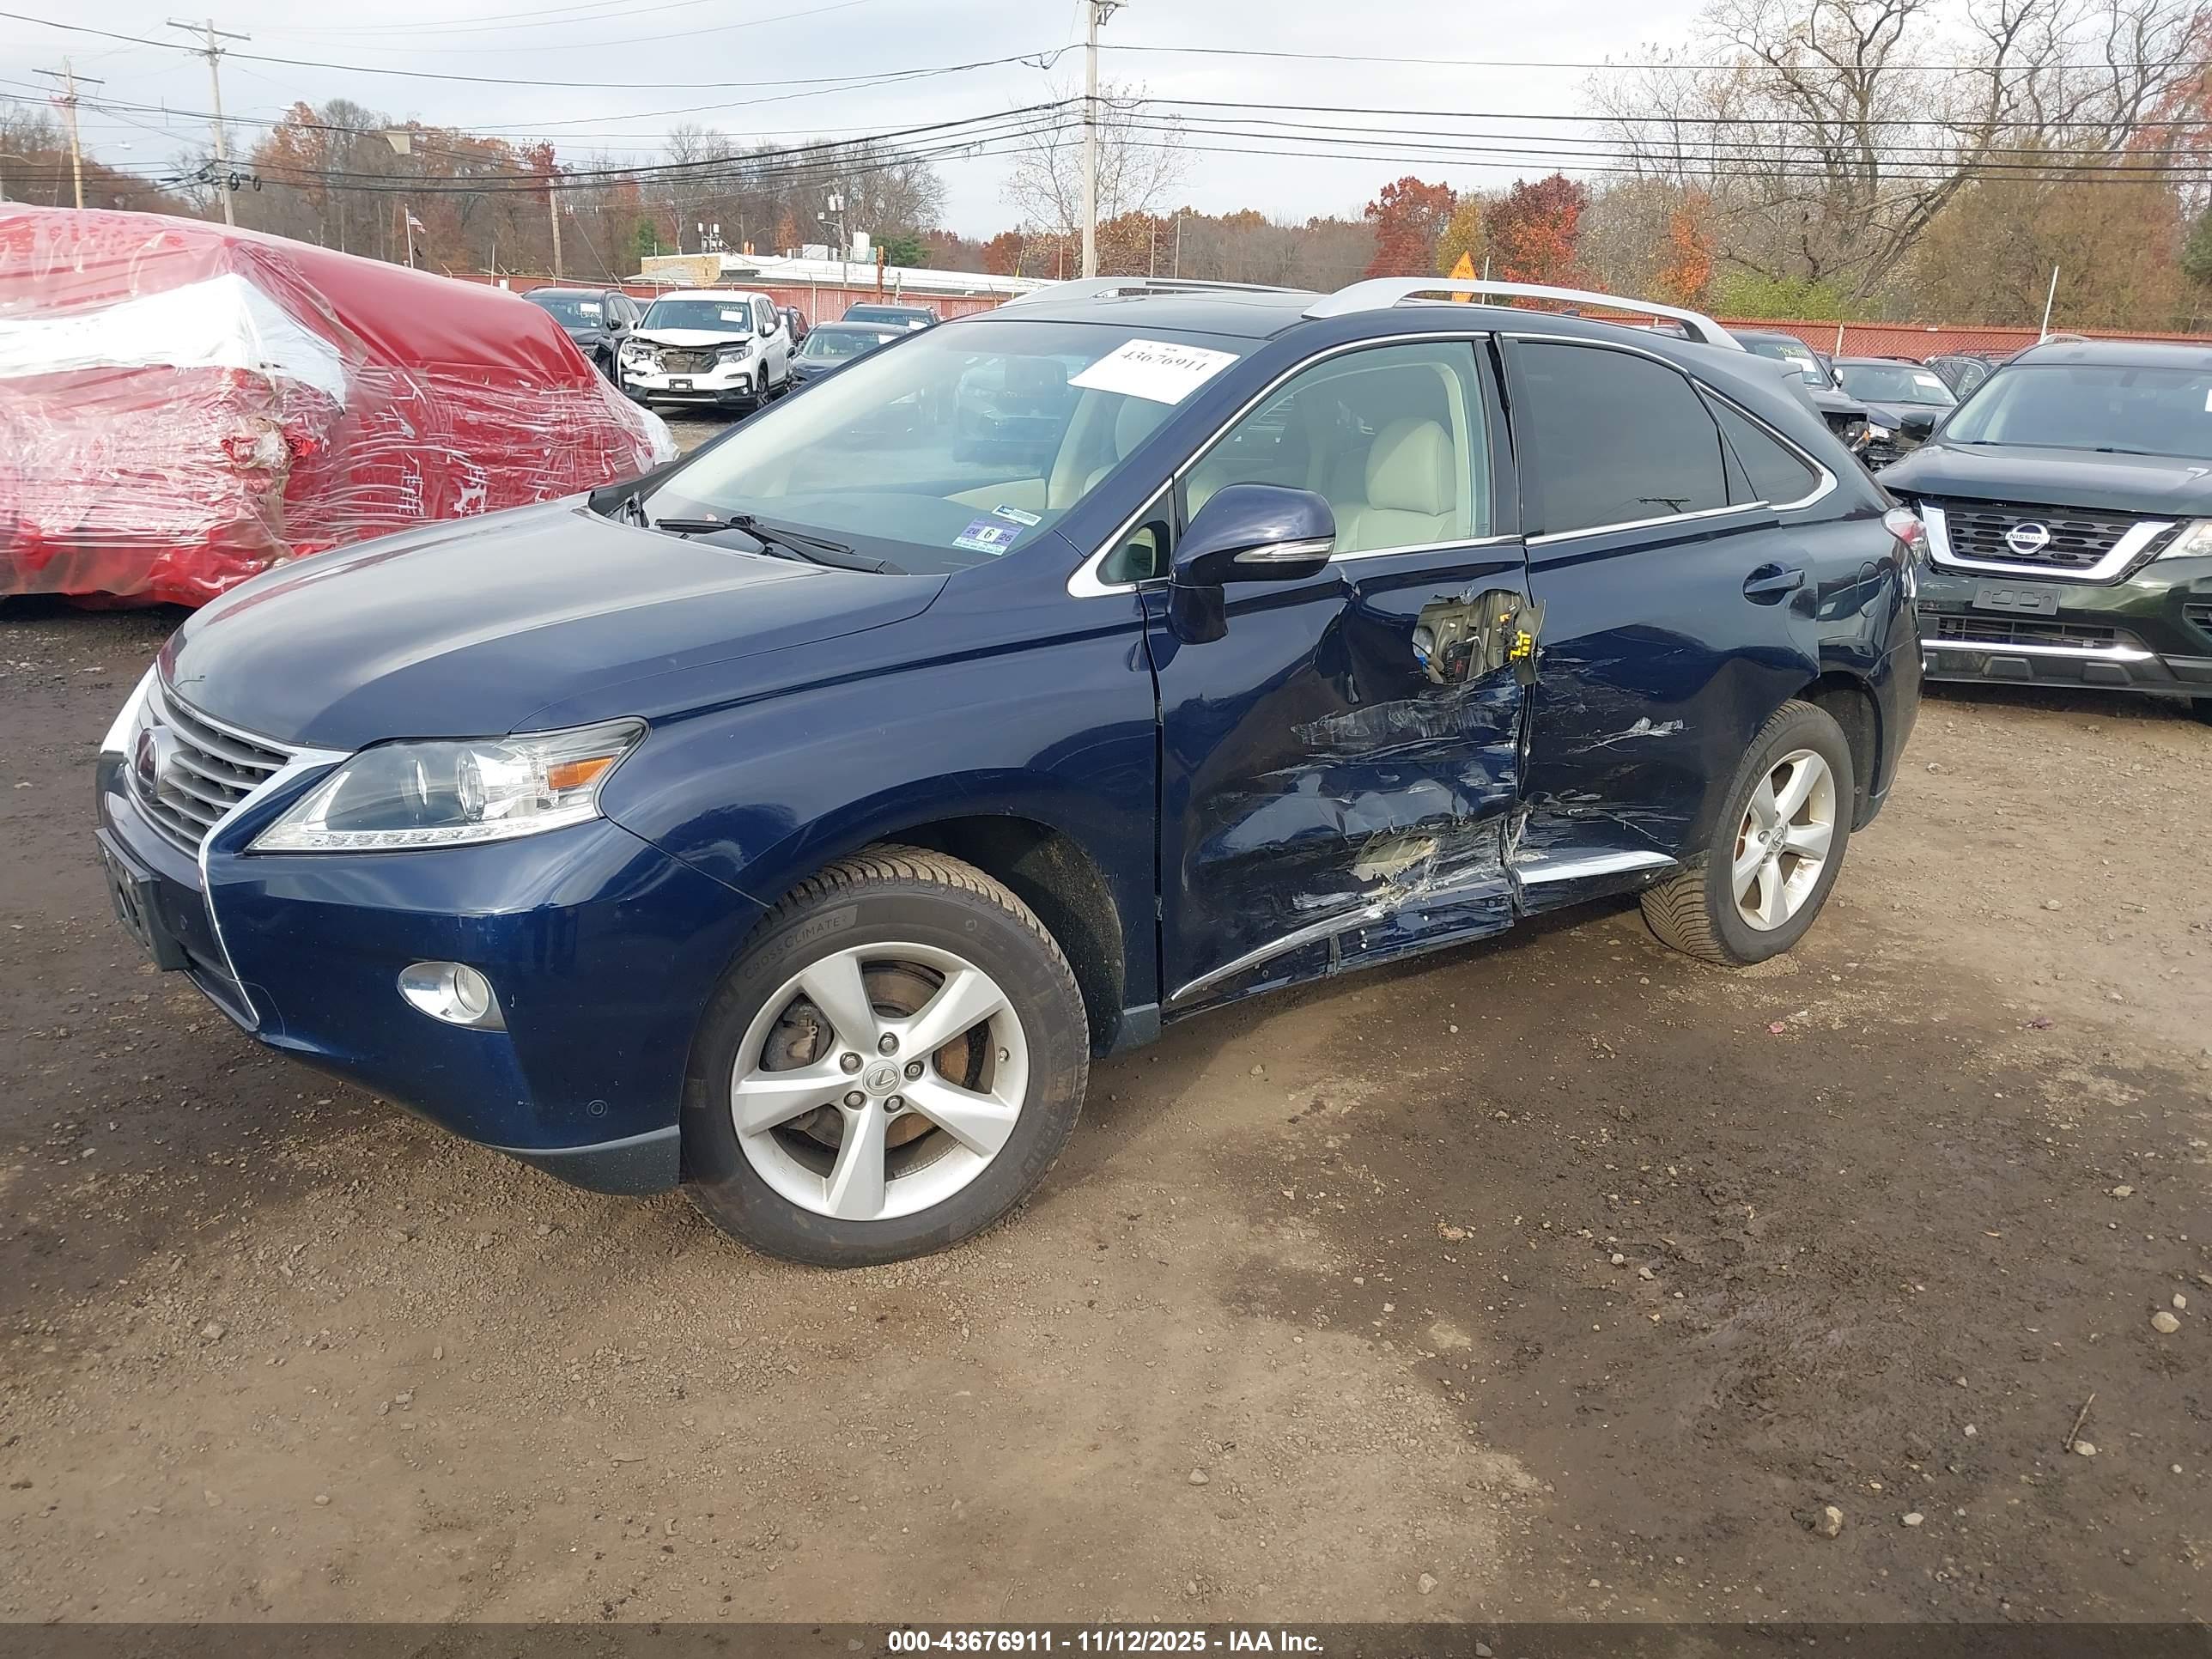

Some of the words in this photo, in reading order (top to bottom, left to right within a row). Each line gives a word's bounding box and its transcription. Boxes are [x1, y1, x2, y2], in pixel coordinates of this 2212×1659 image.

[1121, 350, 1208, 371] 43676911
[983, 528, 995, 539] 6
[999, 533, 1013, 542] 26
